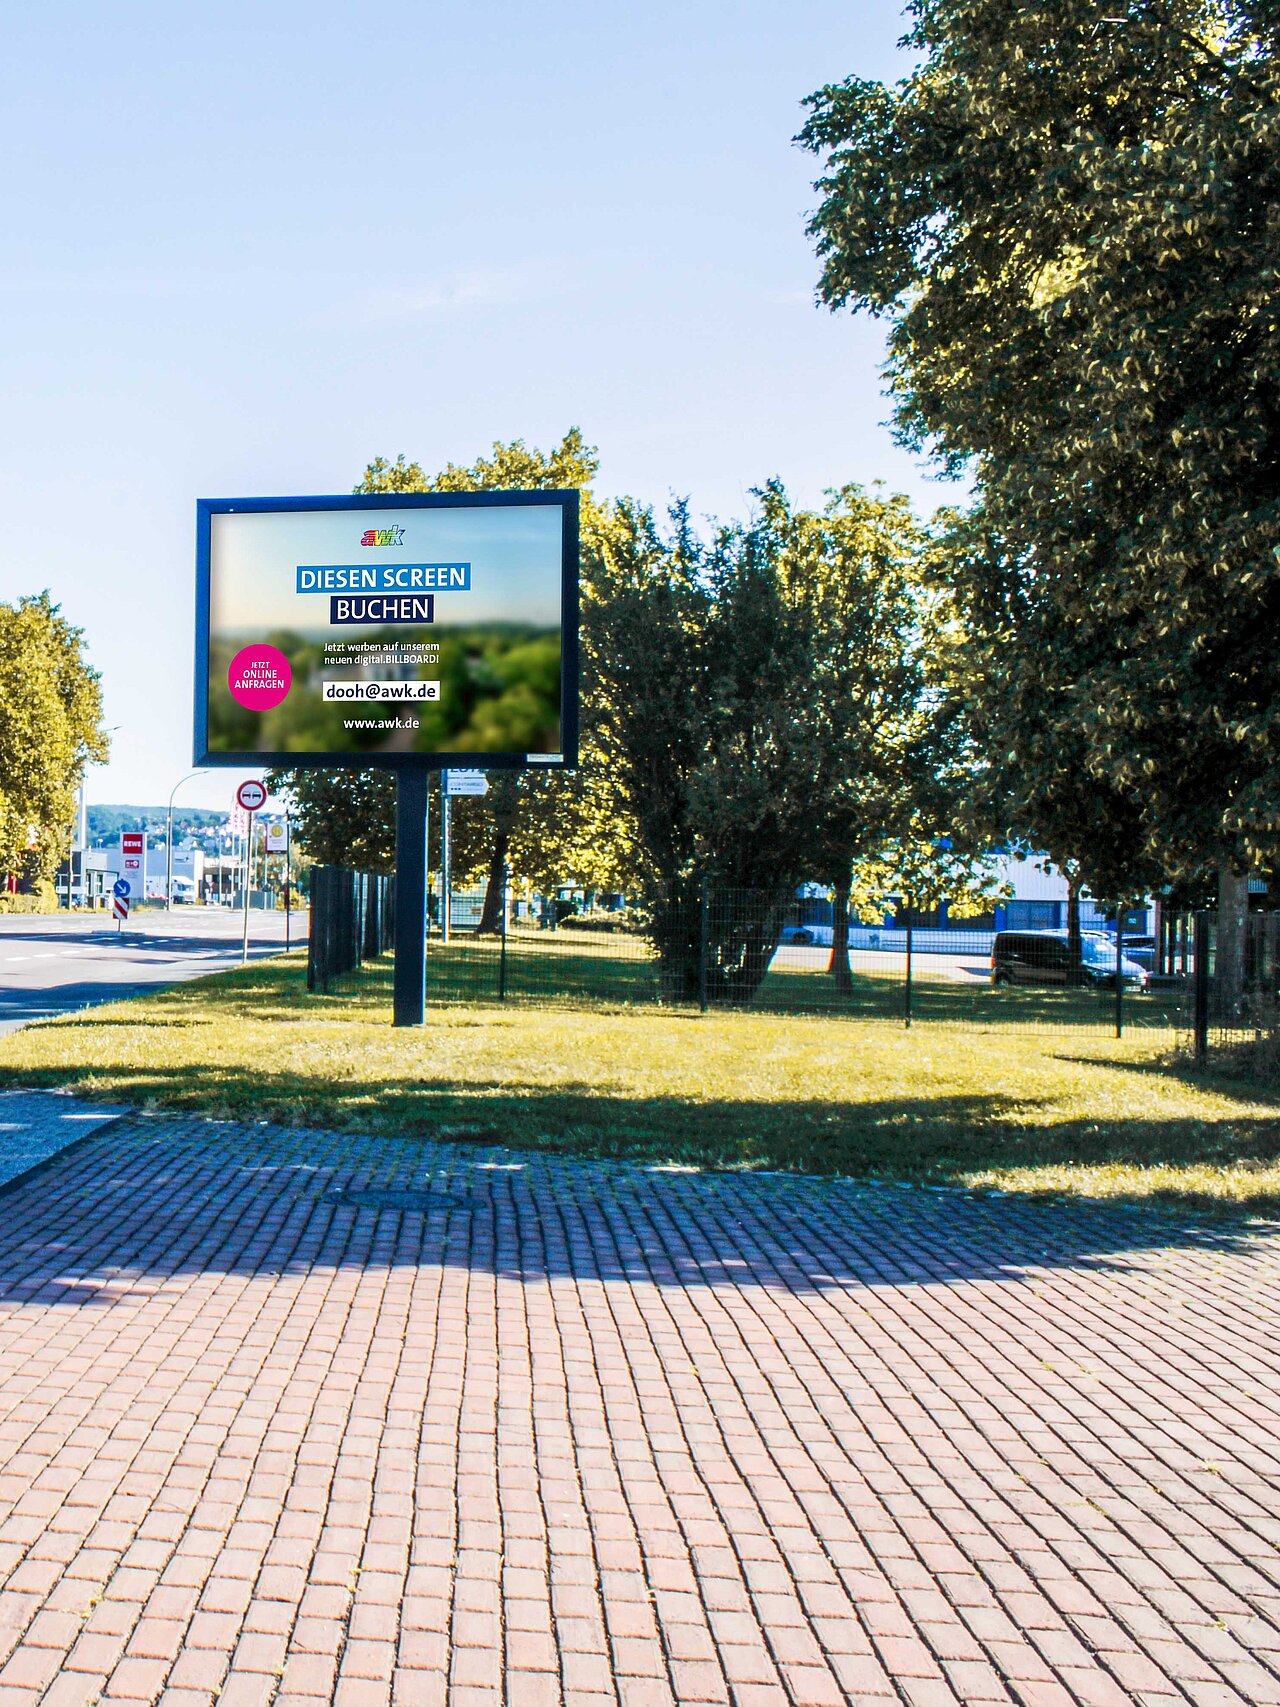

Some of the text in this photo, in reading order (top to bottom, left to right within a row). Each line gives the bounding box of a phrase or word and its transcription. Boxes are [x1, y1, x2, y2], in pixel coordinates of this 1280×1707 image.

[360, 524, 406, 547] awk
[300, 567, 465, 589] DIESEN SCREEN
[336, 598, 429, 620] BUCHEN
[323, 642, 440, 652] Jetzt werben auf unserem
[251, 661, 269, 669] JETZT
[324, 656, 353, 664] neuen
[243, 669, 278, 679] ONLINE
[234, 679, 285, 689] ANFRAGEN
[326, 683, 437, 699] dooh@awk.de
[343, 718, 420, 729] www.awk.de
